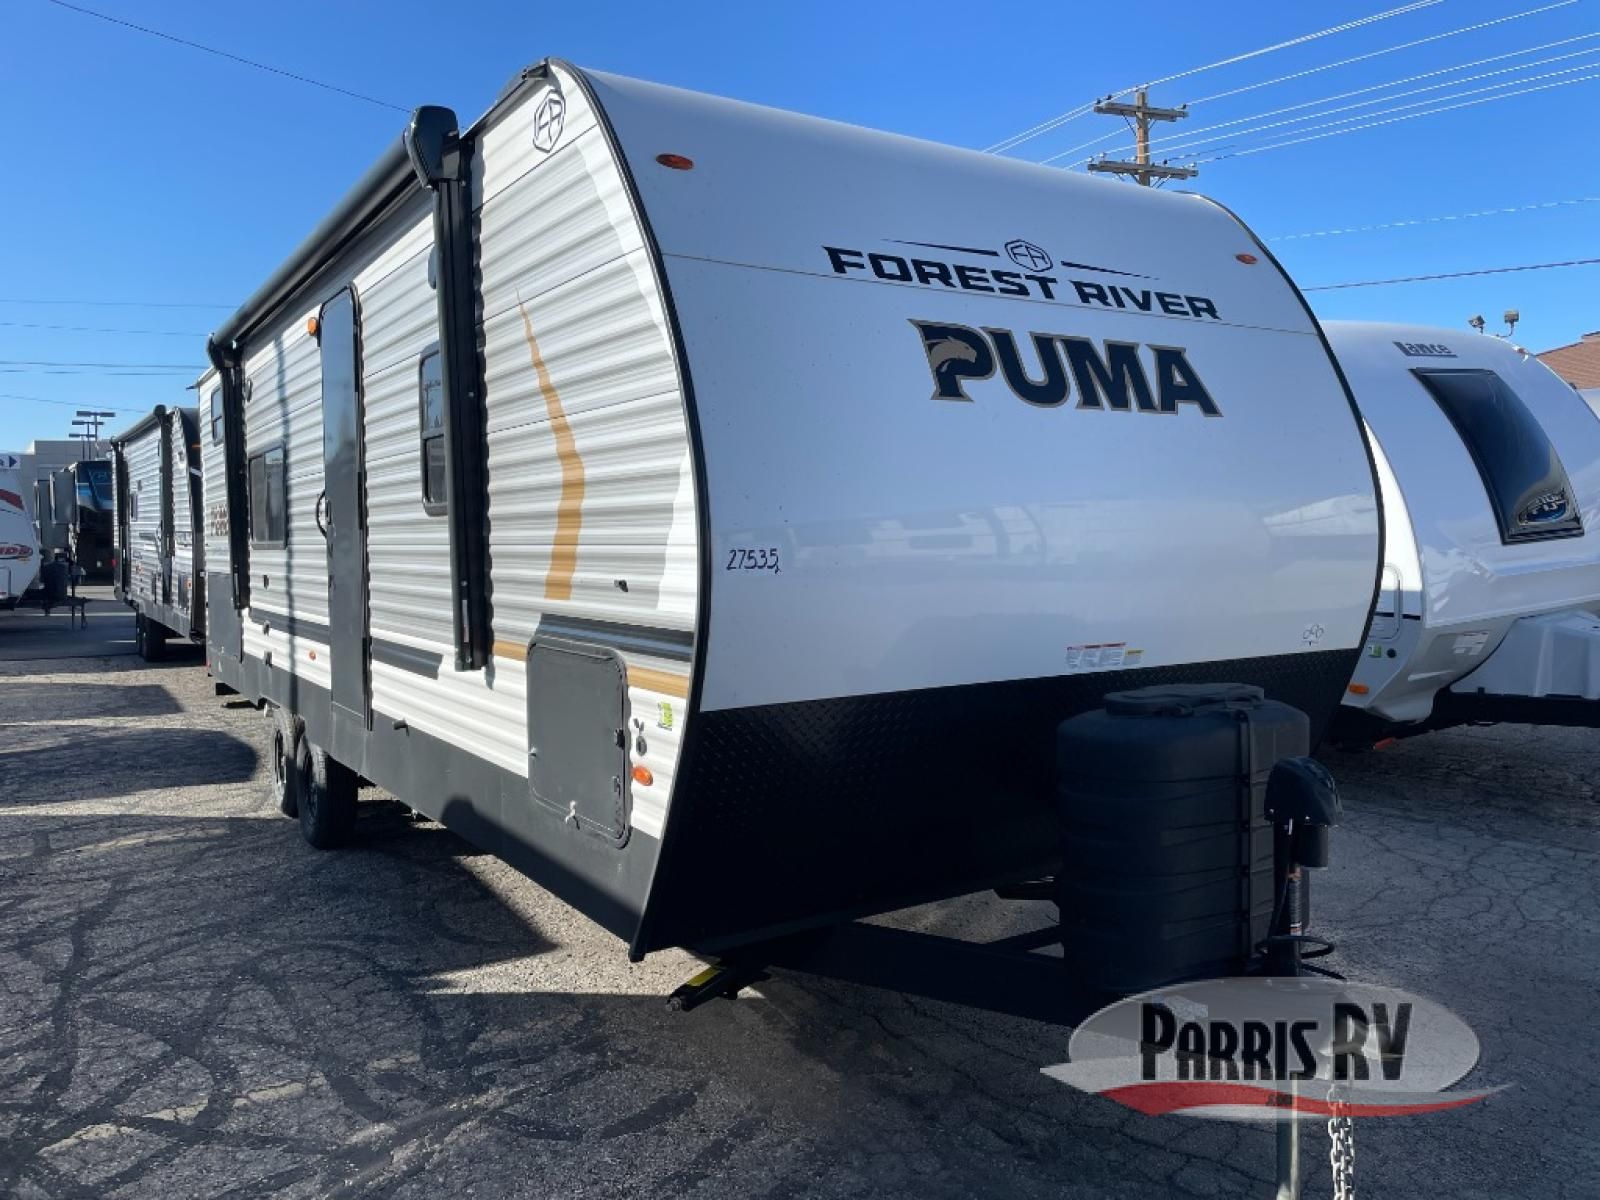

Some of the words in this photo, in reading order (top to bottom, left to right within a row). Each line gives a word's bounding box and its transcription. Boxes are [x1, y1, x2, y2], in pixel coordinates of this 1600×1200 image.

[822, 246, 1058, 300] FOREST
[1068, 279, 1222, 320] RIVER
[907, 318, 1224, 417] PUMA
